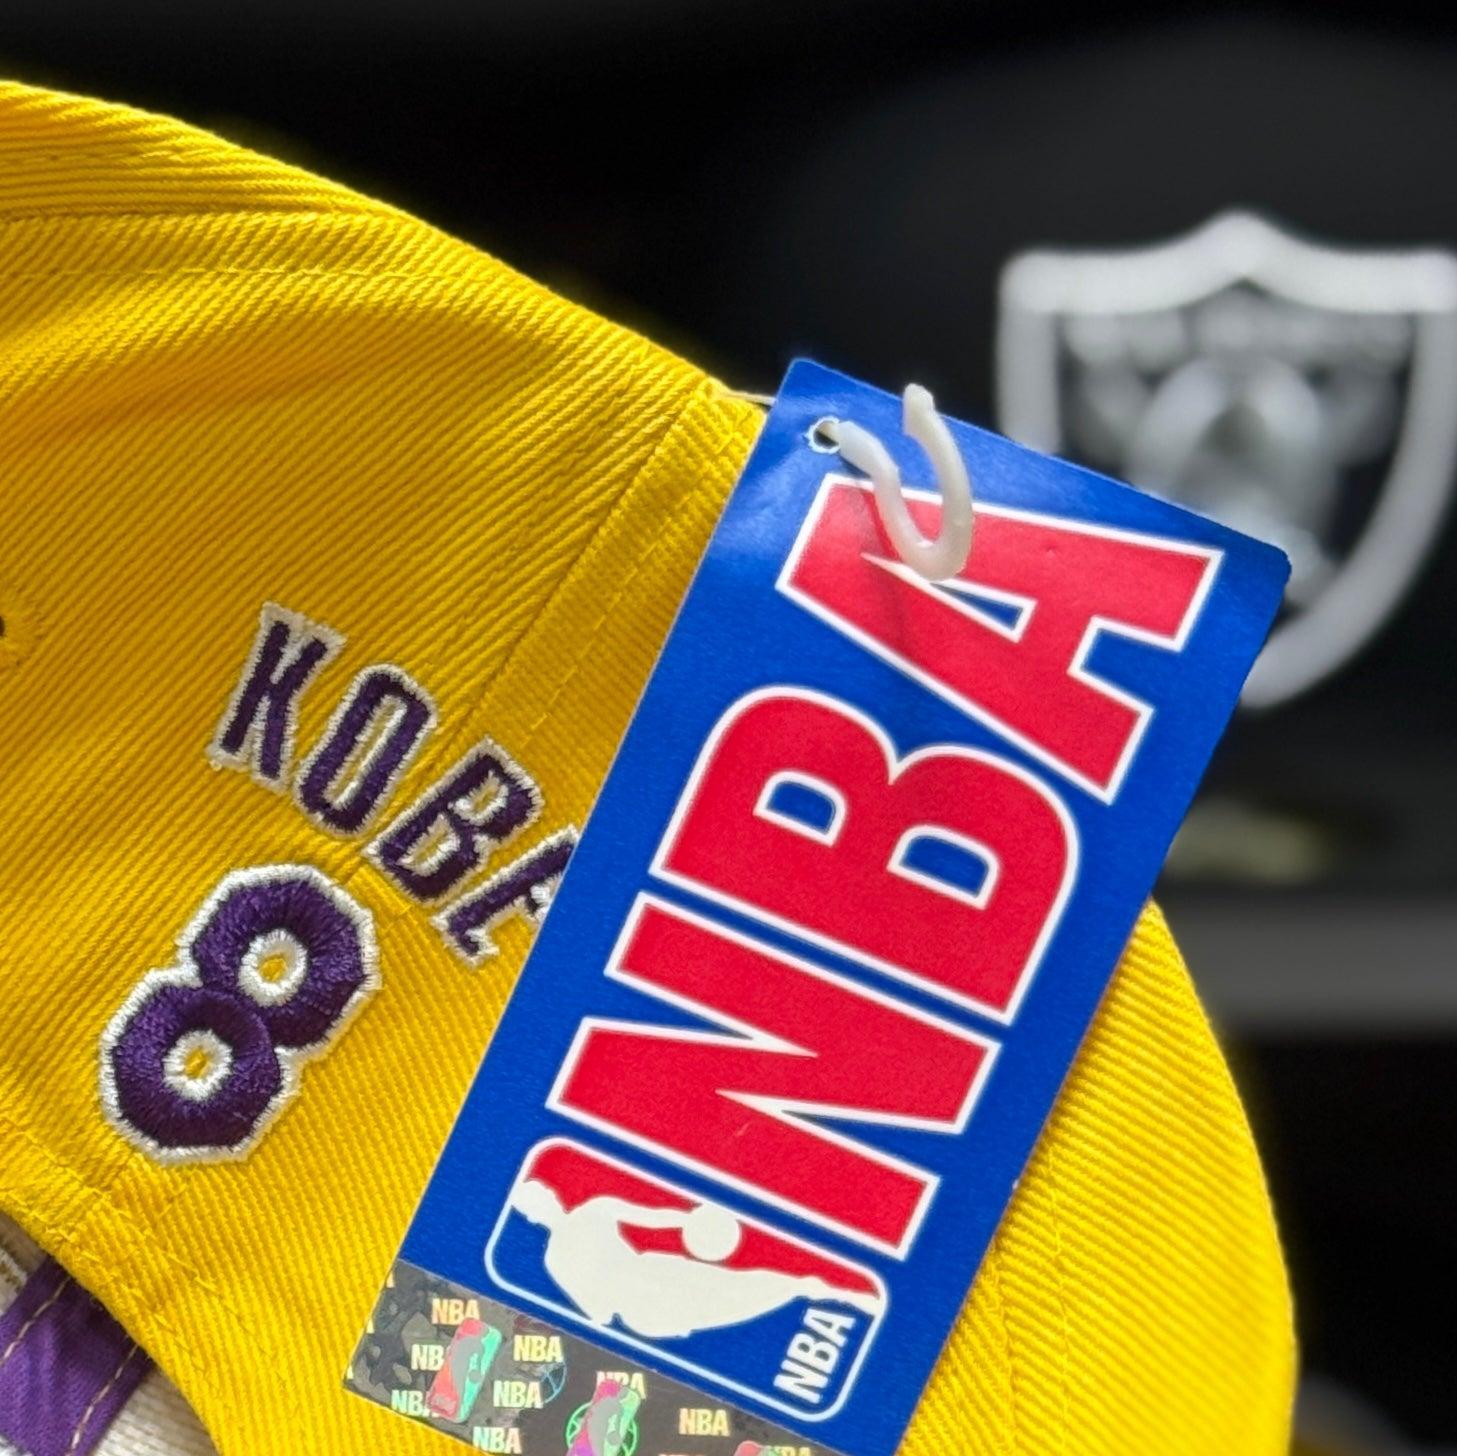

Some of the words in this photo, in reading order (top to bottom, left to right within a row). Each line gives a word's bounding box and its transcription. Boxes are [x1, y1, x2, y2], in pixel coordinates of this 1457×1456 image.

[545, 473, 1223, 1262] NBA
[99, 862, 382, 1166] 8
[432, 1298, 480, 1325] NBA
[411, 1344, 445, 1371] NB
[514, 1334, 563, 1363] NBA
[774, 1307, 857, 1403] NBA
[493, 1380, 544, 1408] NBA
[679, 1408, 729, 1437] NBA
[473, 1426, 522, 1454] NBA
